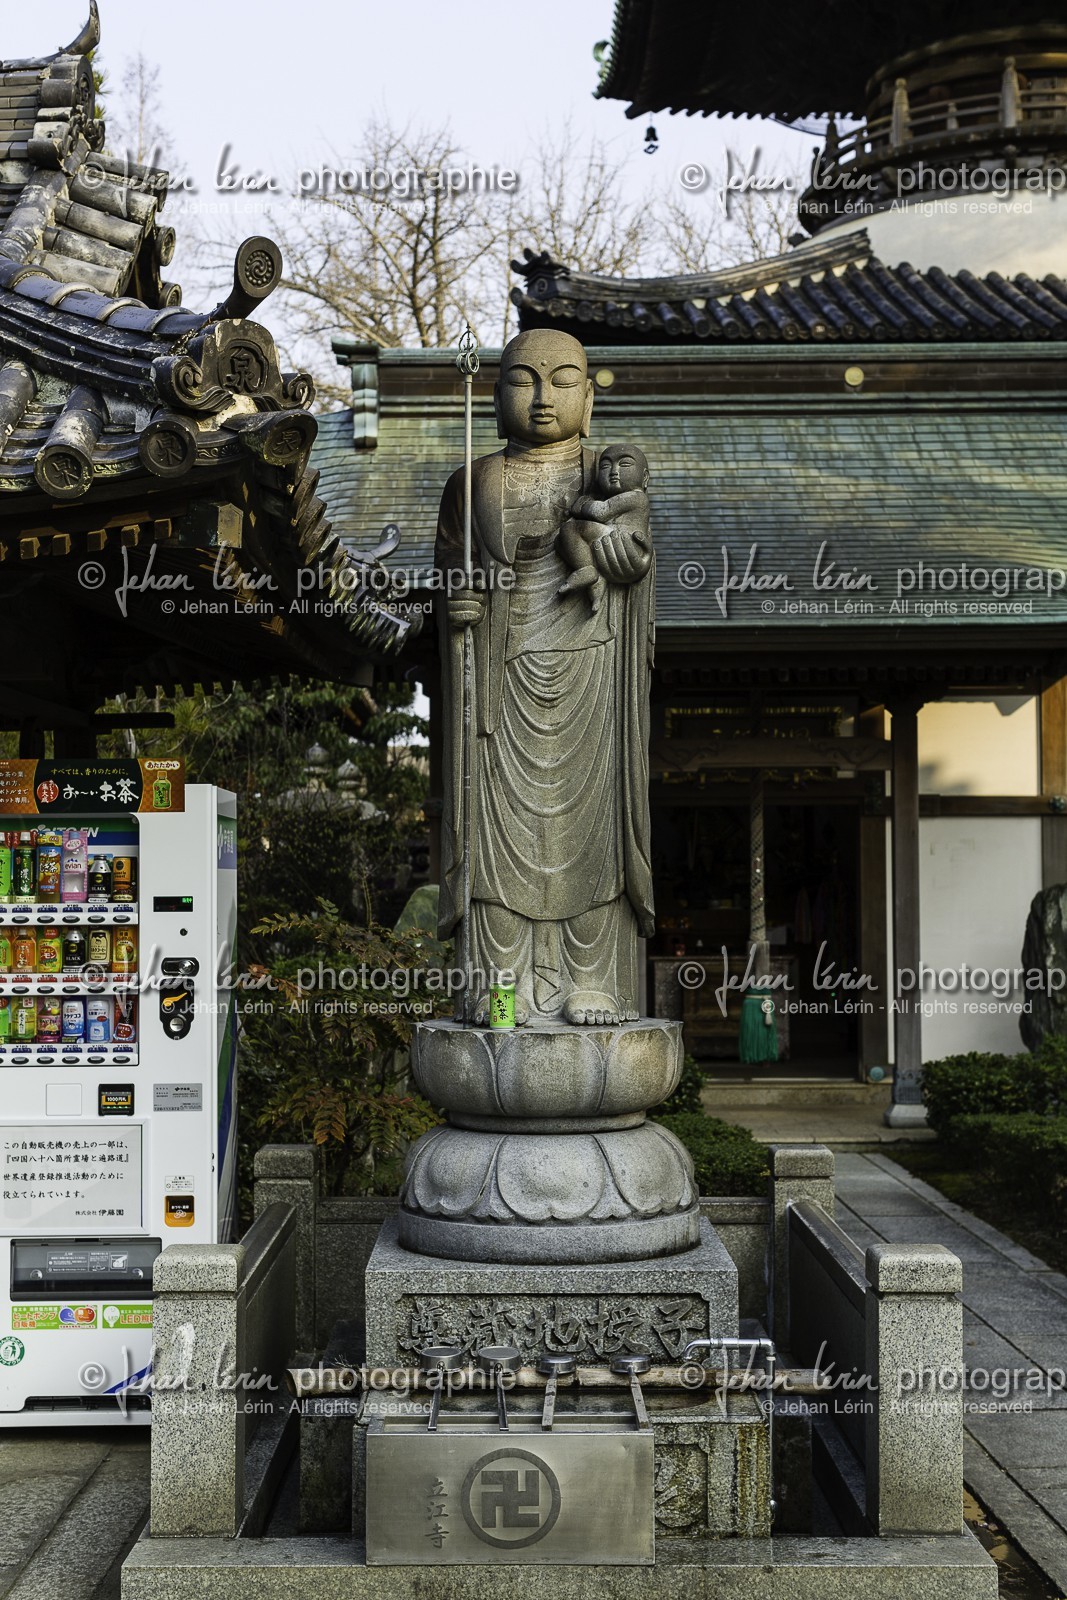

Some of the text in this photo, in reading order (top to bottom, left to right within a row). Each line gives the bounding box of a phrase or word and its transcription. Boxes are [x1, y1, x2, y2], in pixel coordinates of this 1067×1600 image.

[3, 1191, 85, 1199] 役立てられています。
[424, 1477, 450, 1549] 立江寺
